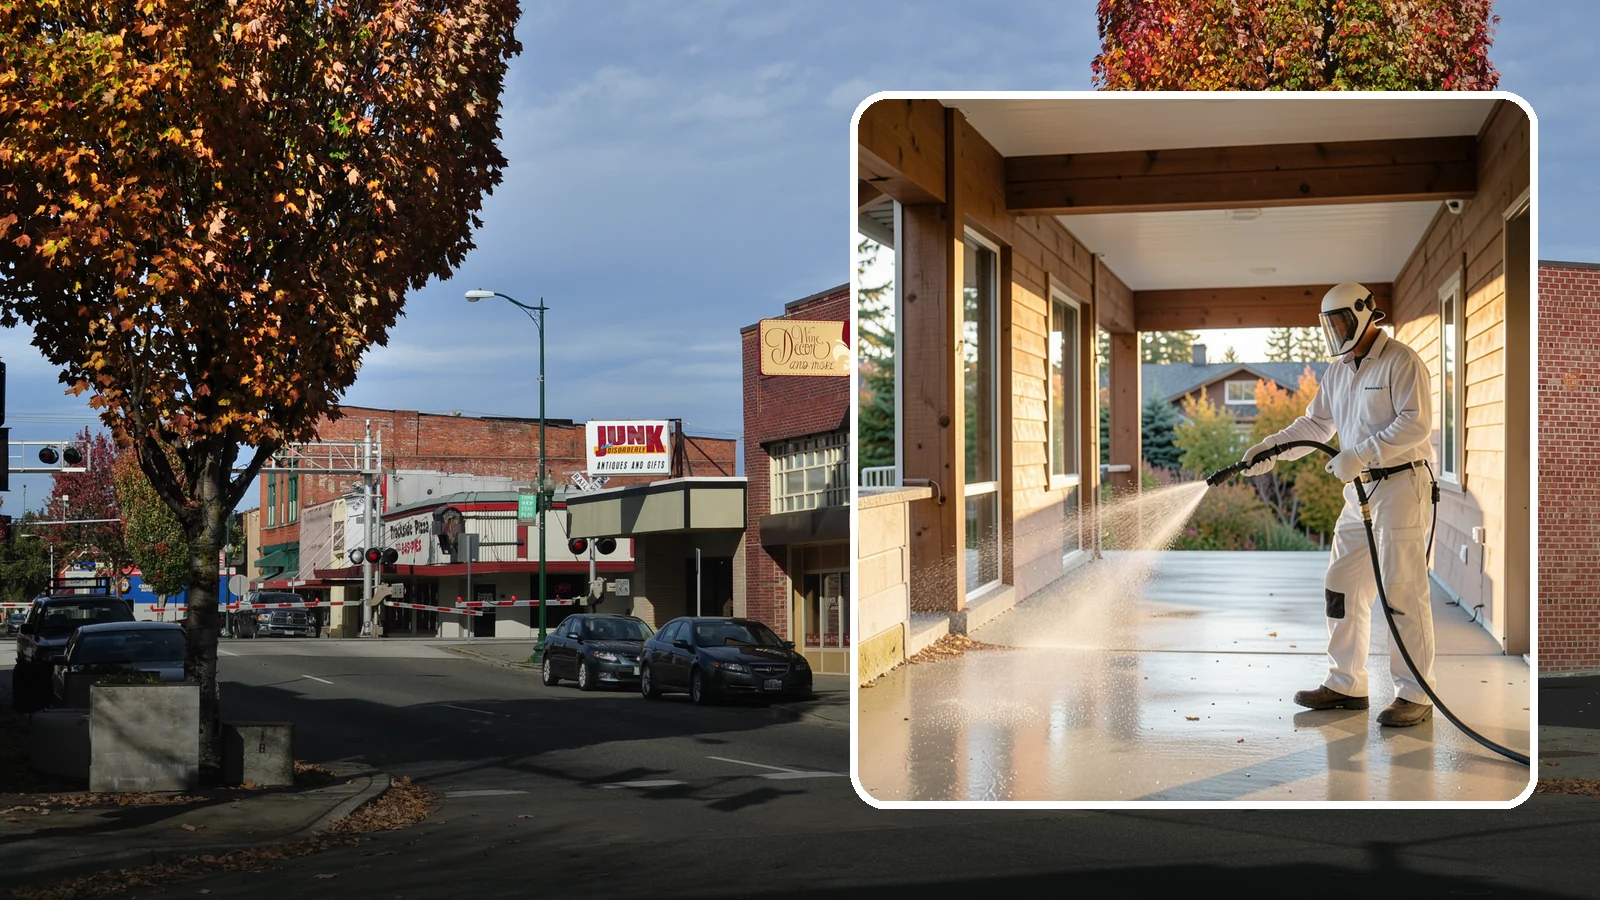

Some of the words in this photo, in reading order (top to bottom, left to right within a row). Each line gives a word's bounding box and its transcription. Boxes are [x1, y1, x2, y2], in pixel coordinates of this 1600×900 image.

[595, 425, 665, 457] JUNK
[607, 446, 646, 454] DISORDERLY
[597, 461, 628, 470] ANTIQUES
[631, 461, 644, 469] AND
[647, 460, 666, 469] GIFTS
[414, 519, 429, 535] Pizza
